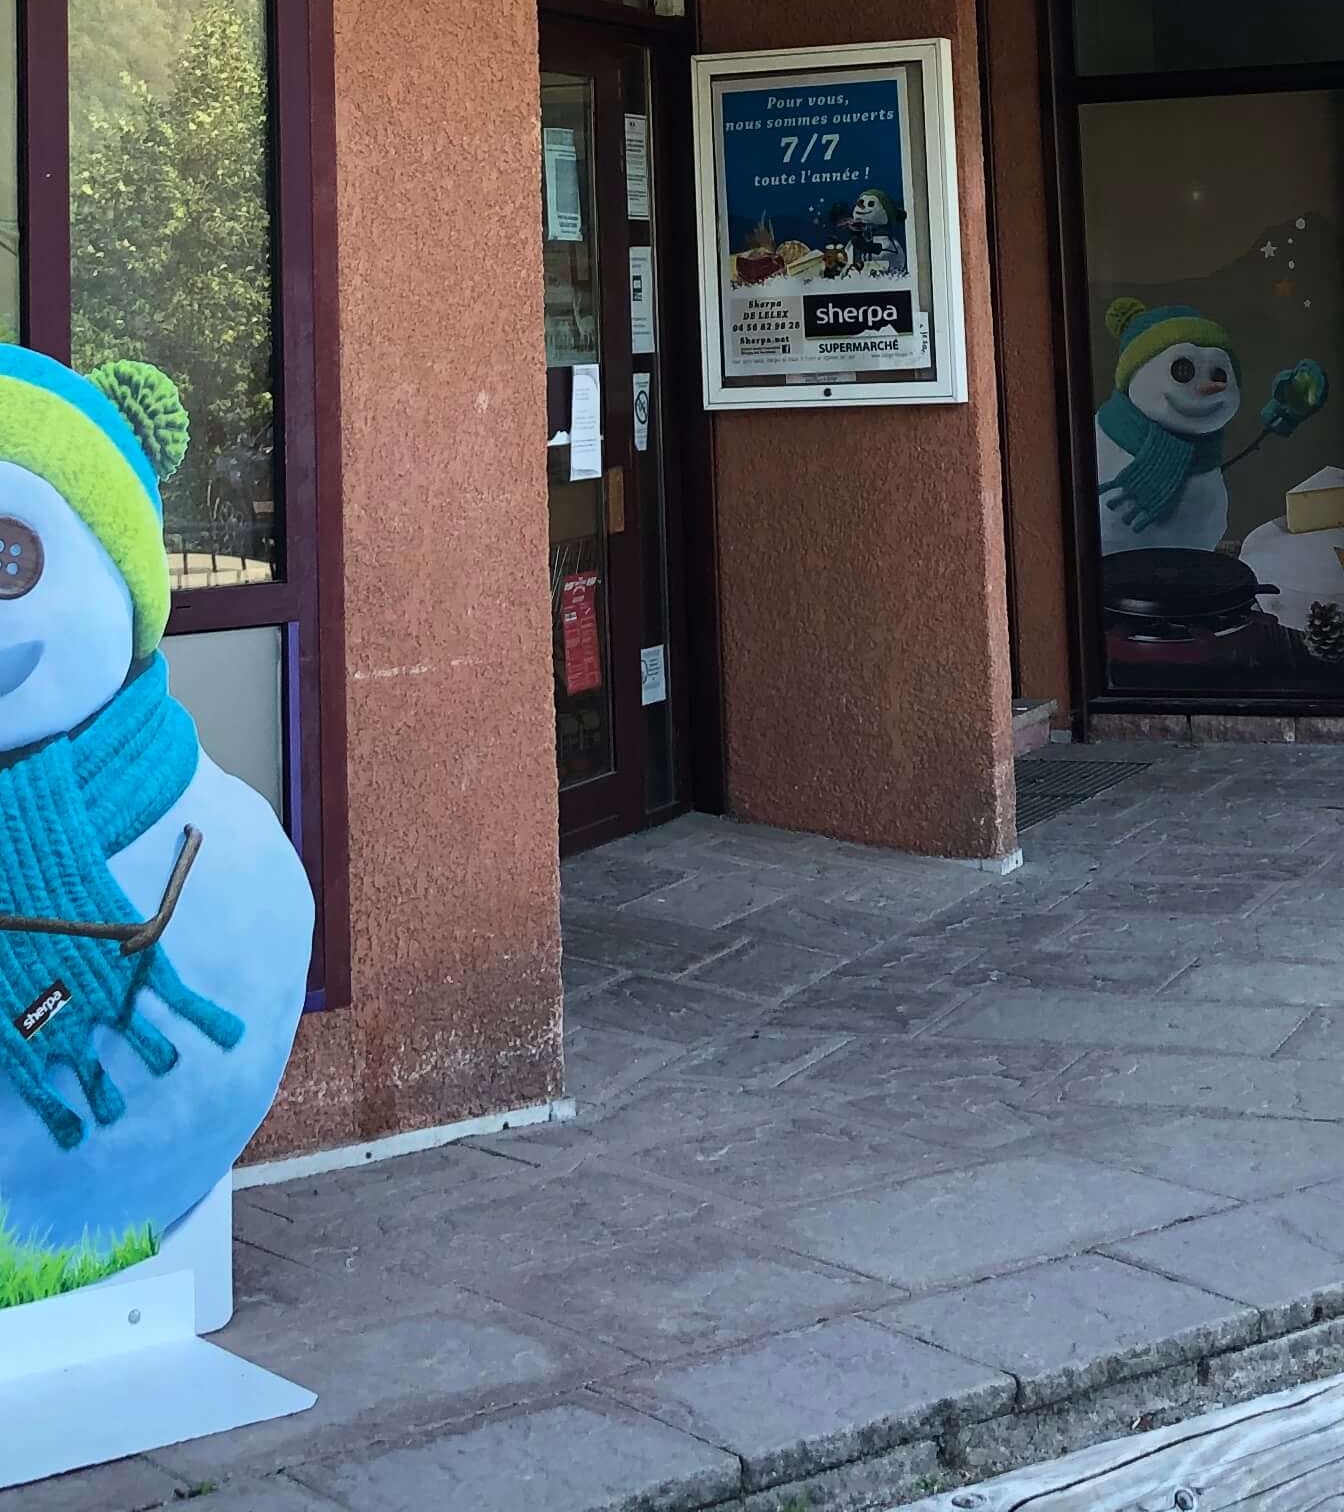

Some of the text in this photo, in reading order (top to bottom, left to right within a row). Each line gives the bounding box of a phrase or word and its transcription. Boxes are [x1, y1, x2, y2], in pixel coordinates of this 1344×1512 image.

[767, 94, 850, 110] Pour vous,
[725, 108, 895, 131] nous sommes ouverts
[779, 132, 840, 164] 7/7
[754, 174, 797, 187] toute
[801, 167, 861, 184] l'année
[816, 302, 899, 327] sherpa
[818, 339, 900, 354] SUPERMARCHÉ
[23, 990, 62, 1030] sherpa
